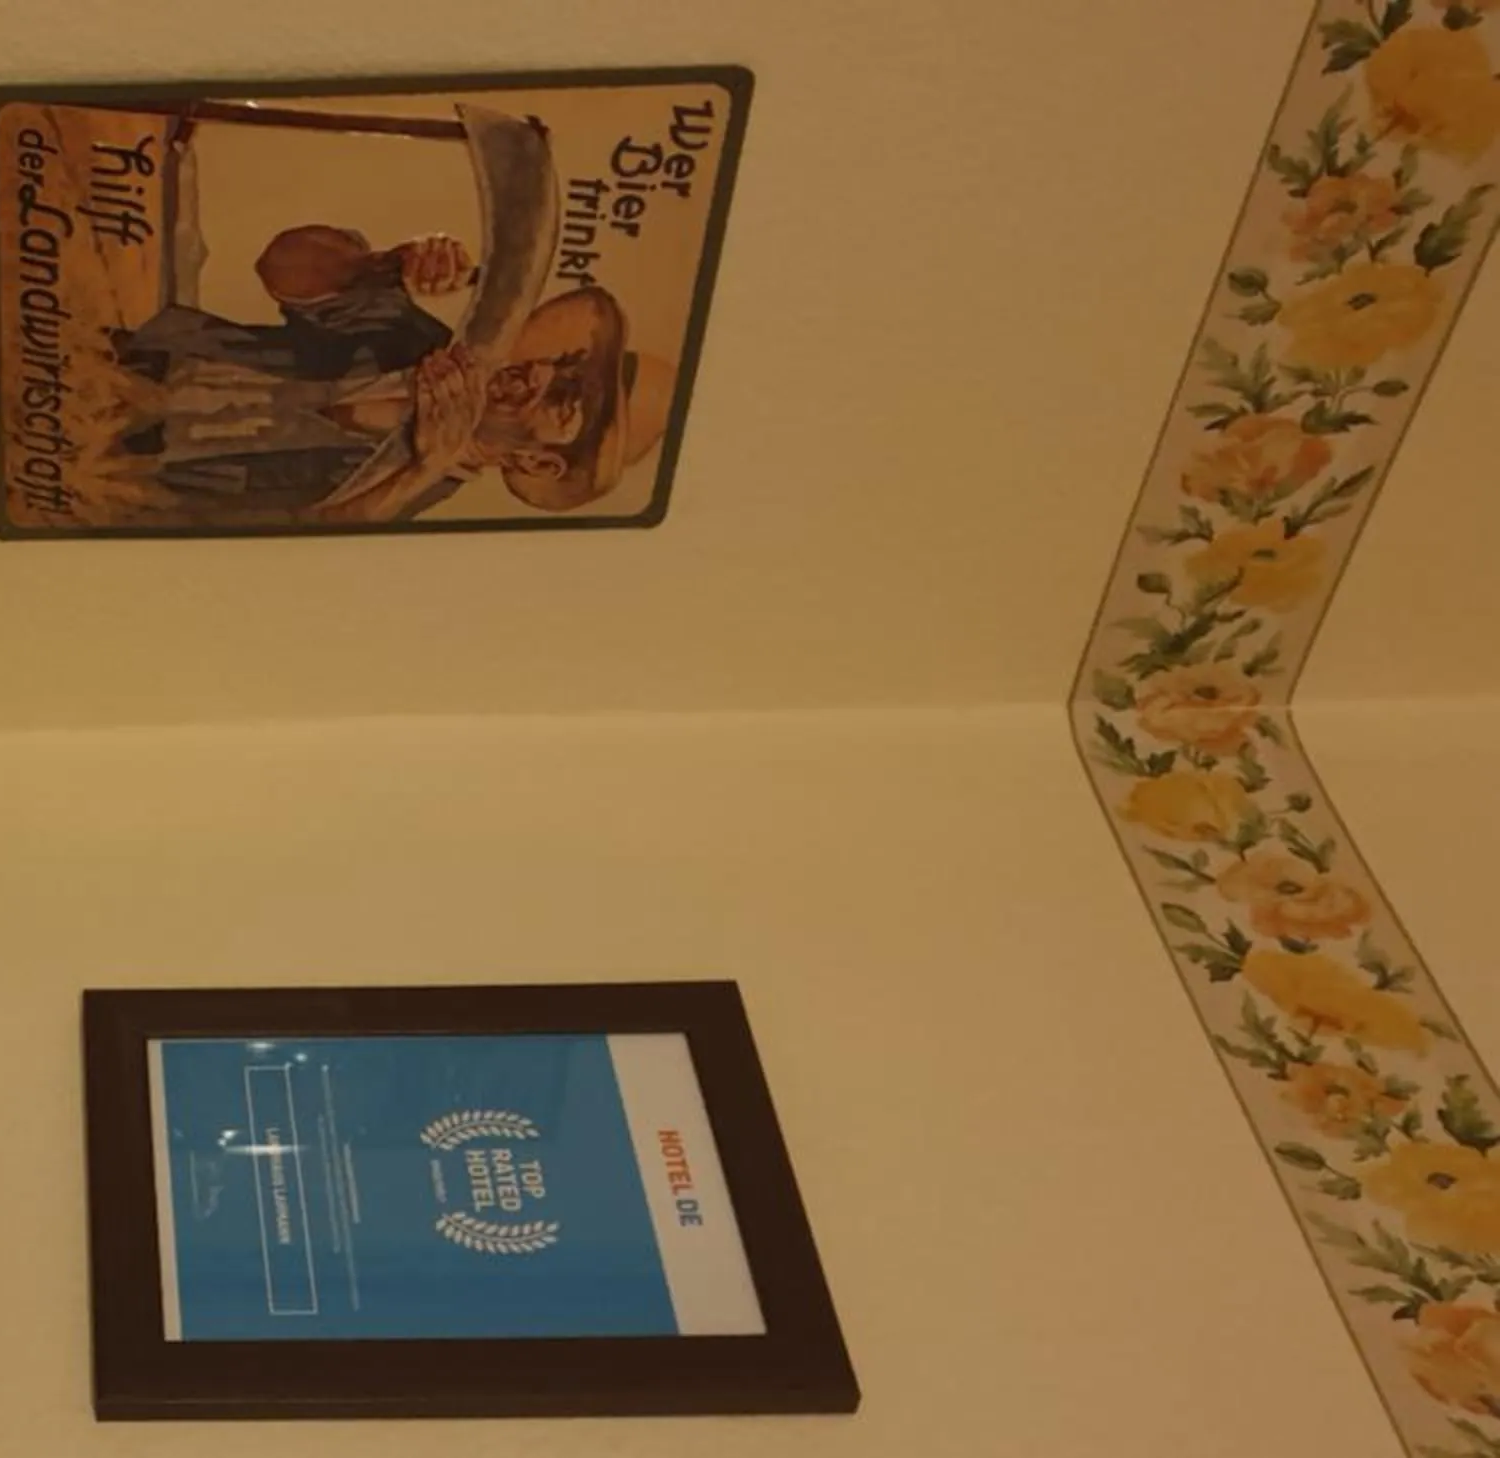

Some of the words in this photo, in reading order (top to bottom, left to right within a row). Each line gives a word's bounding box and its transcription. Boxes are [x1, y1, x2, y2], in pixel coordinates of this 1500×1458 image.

[17, 128, 60, 186] der
[661, 100, 715, 198] Wer
[76, 136, 155, 245] hilft
[610, 136, 664, 239] Bier
[557, 178, 612, 288] trinkt
[265, 1127, 286, 1186] LANHAUS
[464, 1150, 495, 1213] HOTEL
[491, 1148, 520, 1212] RATED
[519, 1159, 546, 1200] TOP
[657, 1130, 691, 1196] HOTEL
